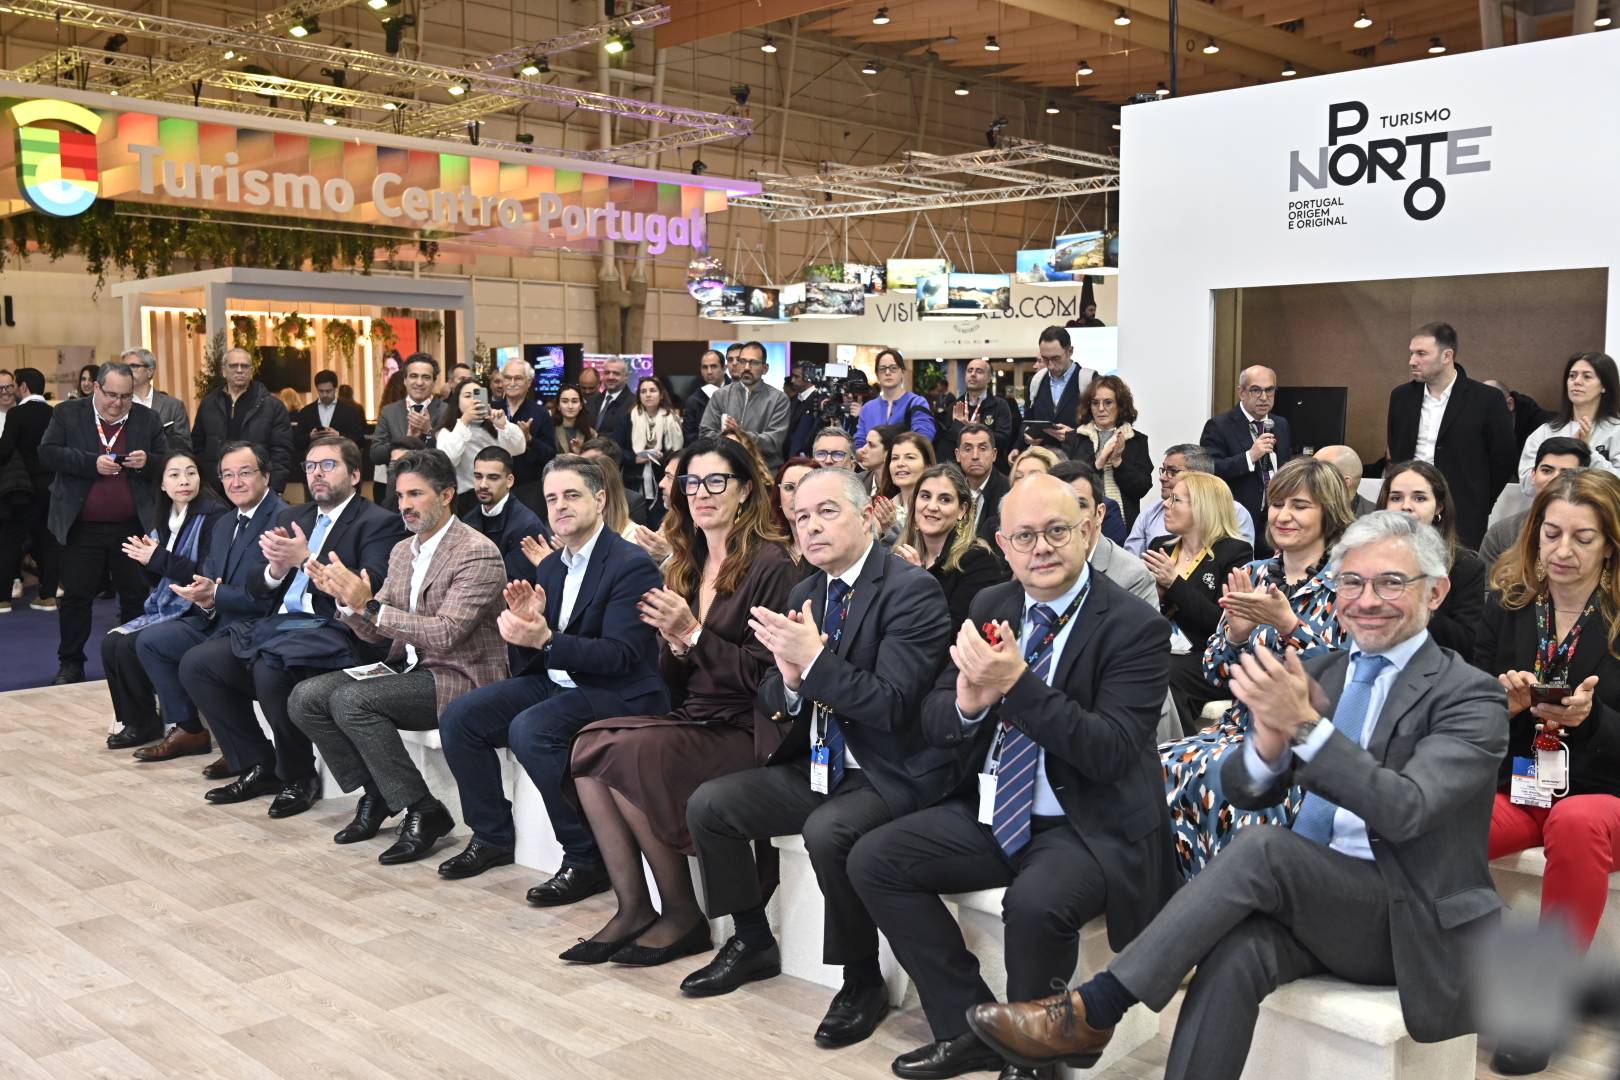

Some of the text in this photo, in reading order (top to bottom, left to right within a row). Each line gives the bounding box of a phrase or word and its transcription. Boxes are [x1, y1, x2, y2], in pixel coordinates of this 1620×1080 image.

[1380, 107, 1452, 129] TURISMO
[128, 143, 707, 256] Turismo Centro Portugal
[1288, 197, 1344, 210] PORTUGAL
[1288, 208, 1330, 220] ORIGEM
[1288, 216, 1348, 230] E ORIGINAL
